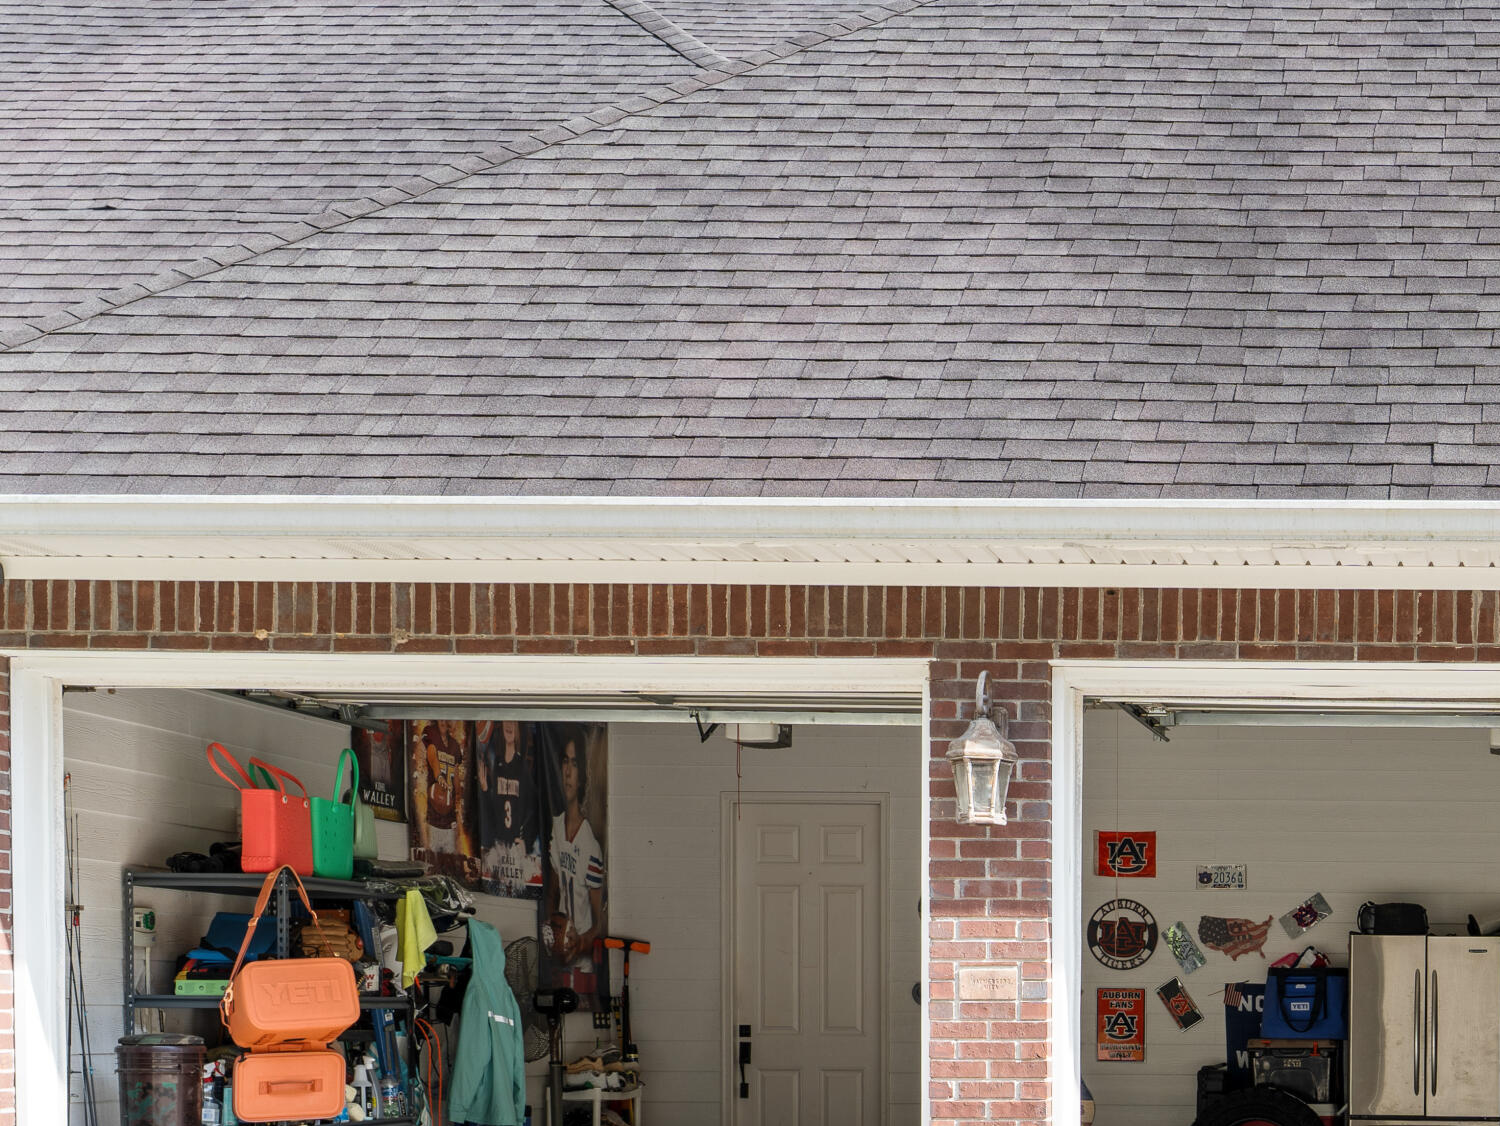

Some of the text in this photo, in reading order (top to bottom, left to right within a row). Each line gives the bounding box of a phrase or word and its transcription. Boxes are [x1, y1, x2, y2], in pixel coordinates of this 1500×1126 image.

[362, 789, 396, 807] WALLEY
[504, 800, 512, 829] 3
[1213, 871, 1236, 884] 2036
[1099, 900, 1149, 919] AUBURN
[1098, 953, 1146, 970] TIGERS
[260, 978, 343, 1006] YETI
[1102, 991, 1142, 1000] AUBURN
[1109, 1000, 1135, 1010] FANS
